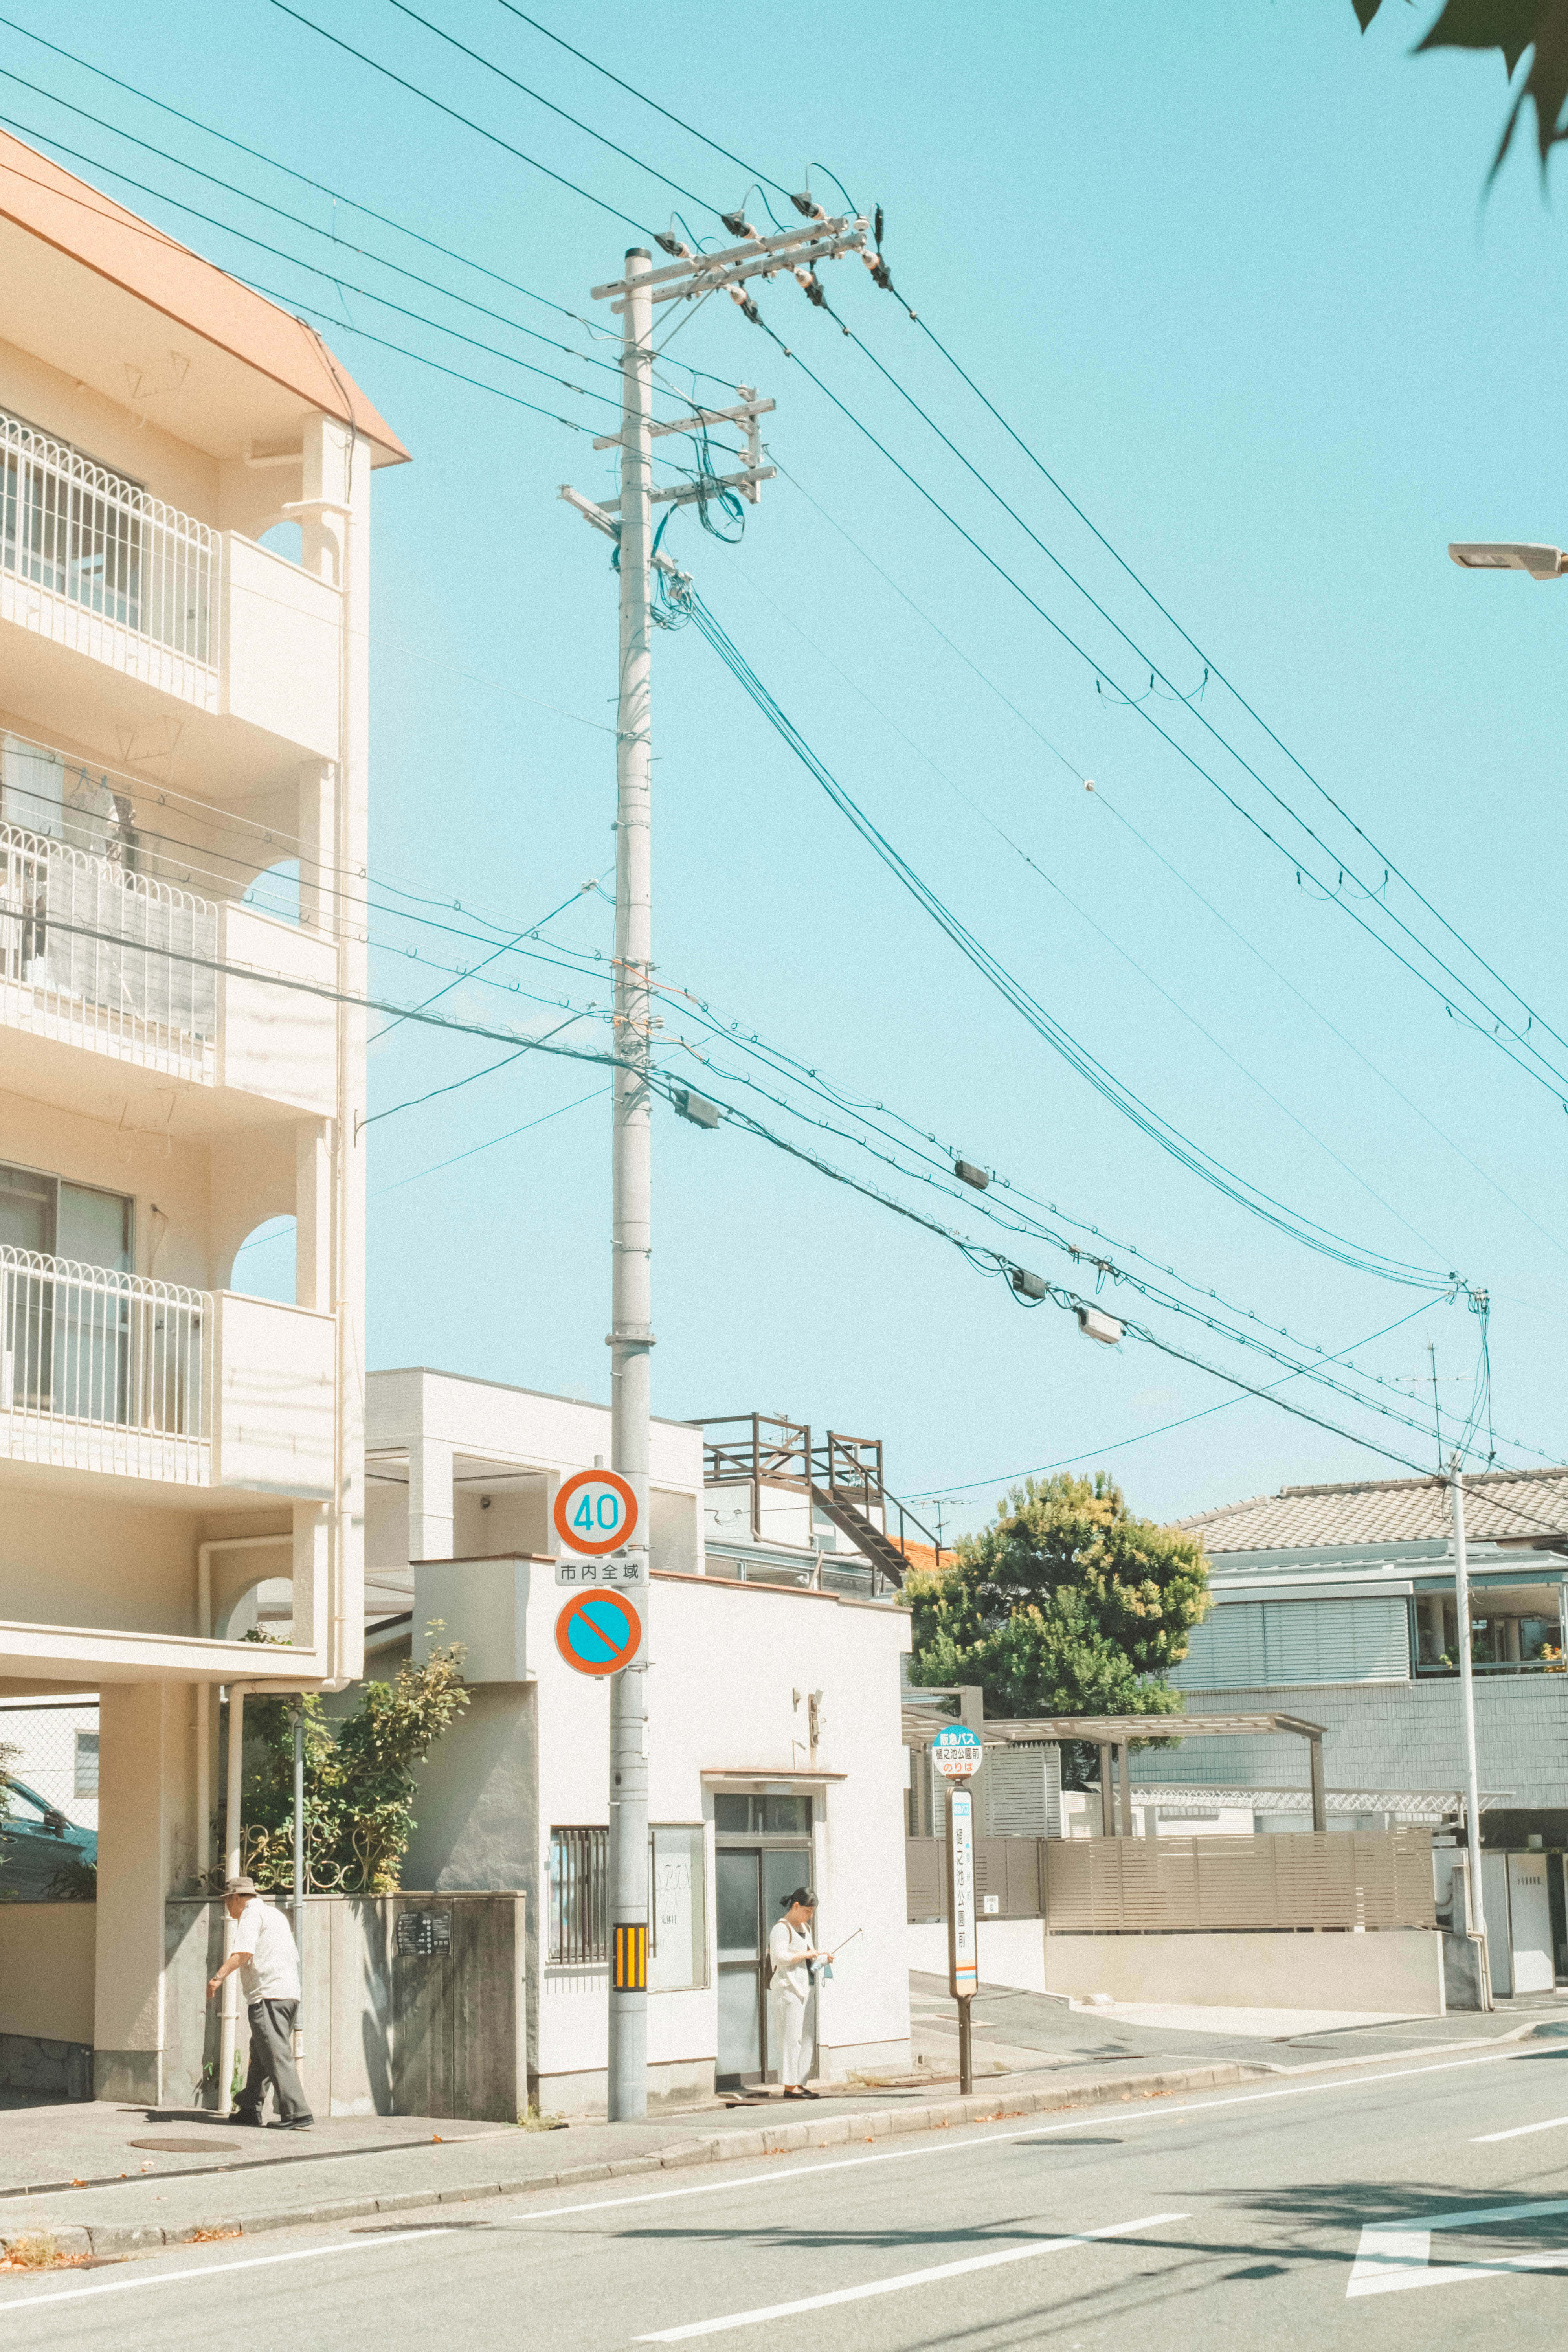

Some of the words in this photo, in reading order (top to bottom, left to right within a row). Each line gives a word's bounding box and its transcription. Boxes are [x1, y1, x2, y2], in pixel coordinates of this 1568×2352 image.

[574, 1494, 618, 1530] 40
[561, 1564, 639, 1580] 市内全域
[940, 1733, 975, 1746] 阪急バス
[936, 1748, 979, 1760] 樋之池公園前
[944, 1763, 973, 1772] のりば
[956, 1829, 965, 1948] 樋之池公園前
